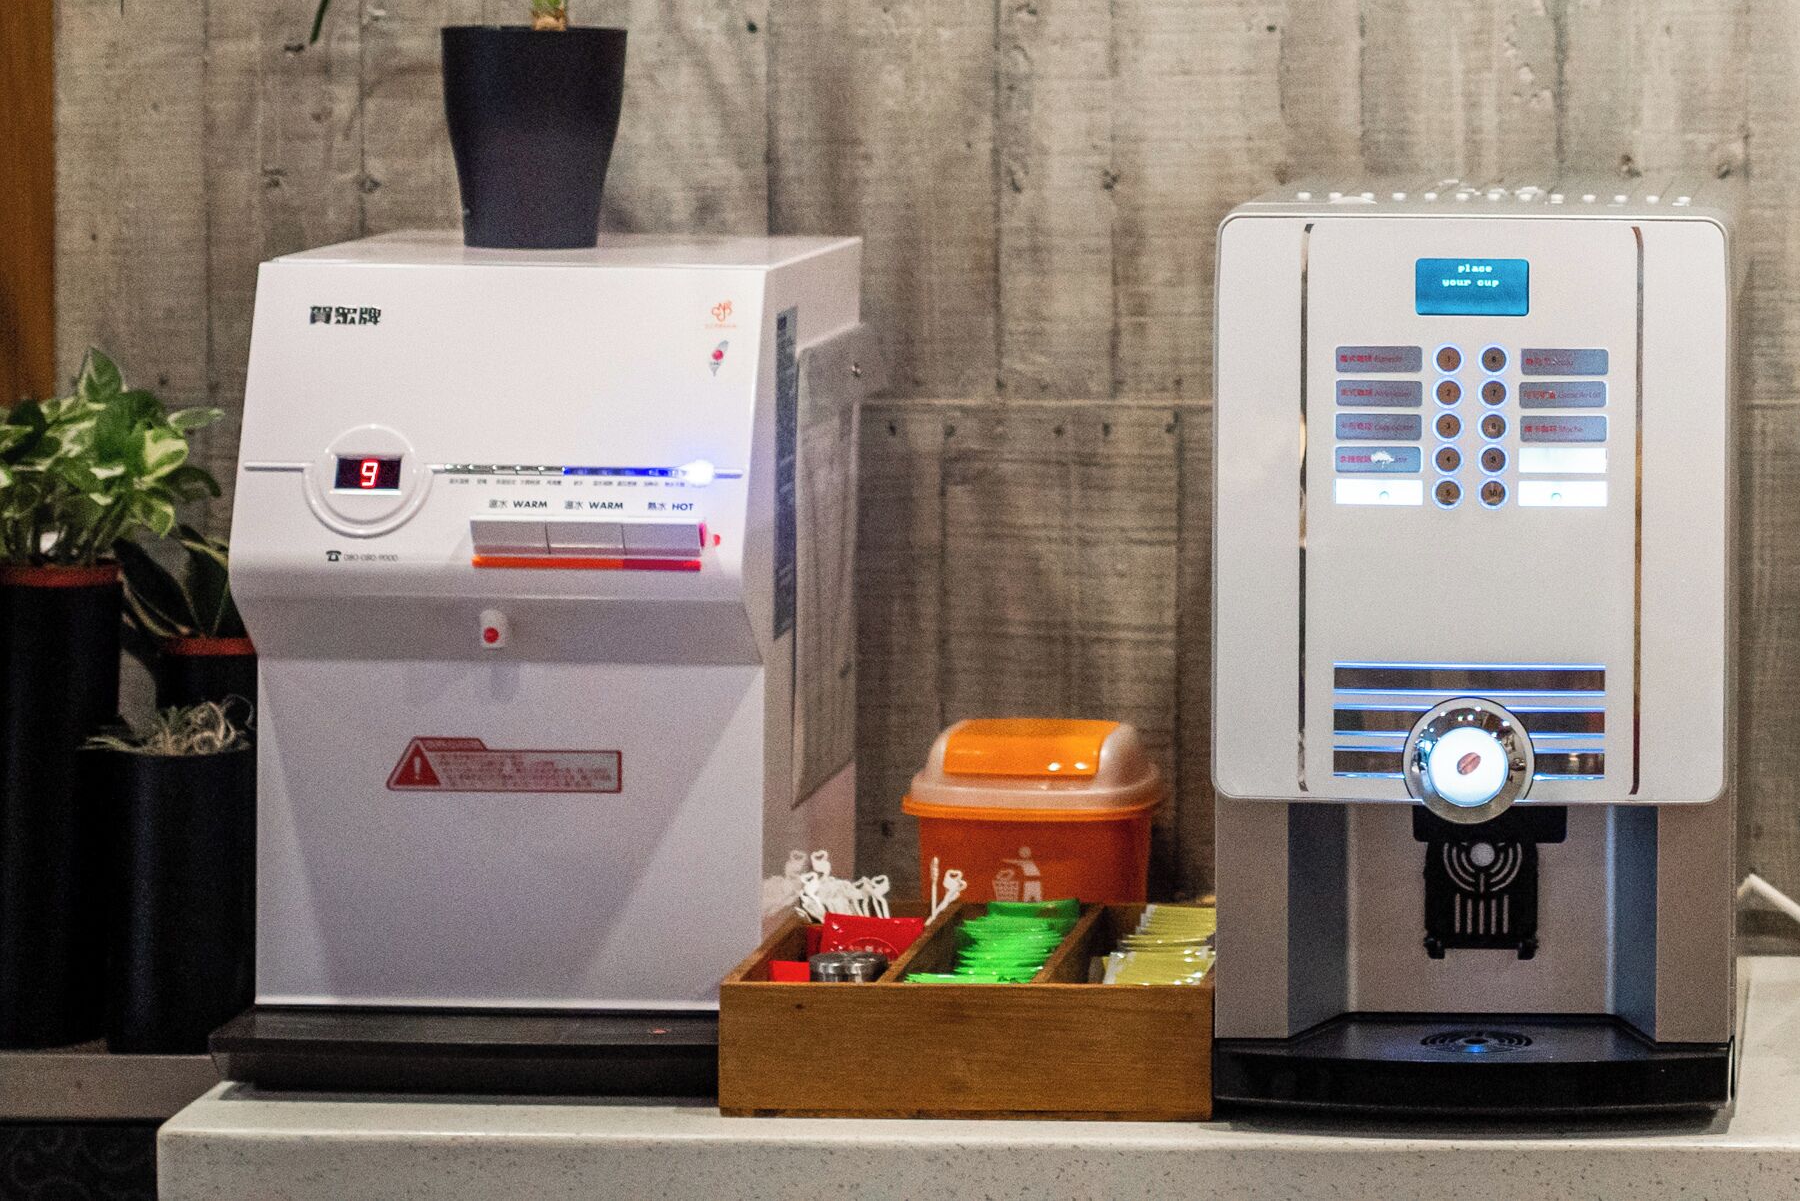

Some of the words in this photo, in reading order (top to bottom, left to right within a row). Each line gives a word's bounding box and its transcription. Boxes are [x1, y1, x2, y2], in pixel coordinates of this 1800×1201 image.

[1442, 279, 1471, 287] your
[1477, 279, 1499, 288] cup
[361, 461, 379, 487] 9
[513, 500, 548, 509] WARM
[589, 501, 624, 510] WARM
[672, 502, 693, 511] HOT
